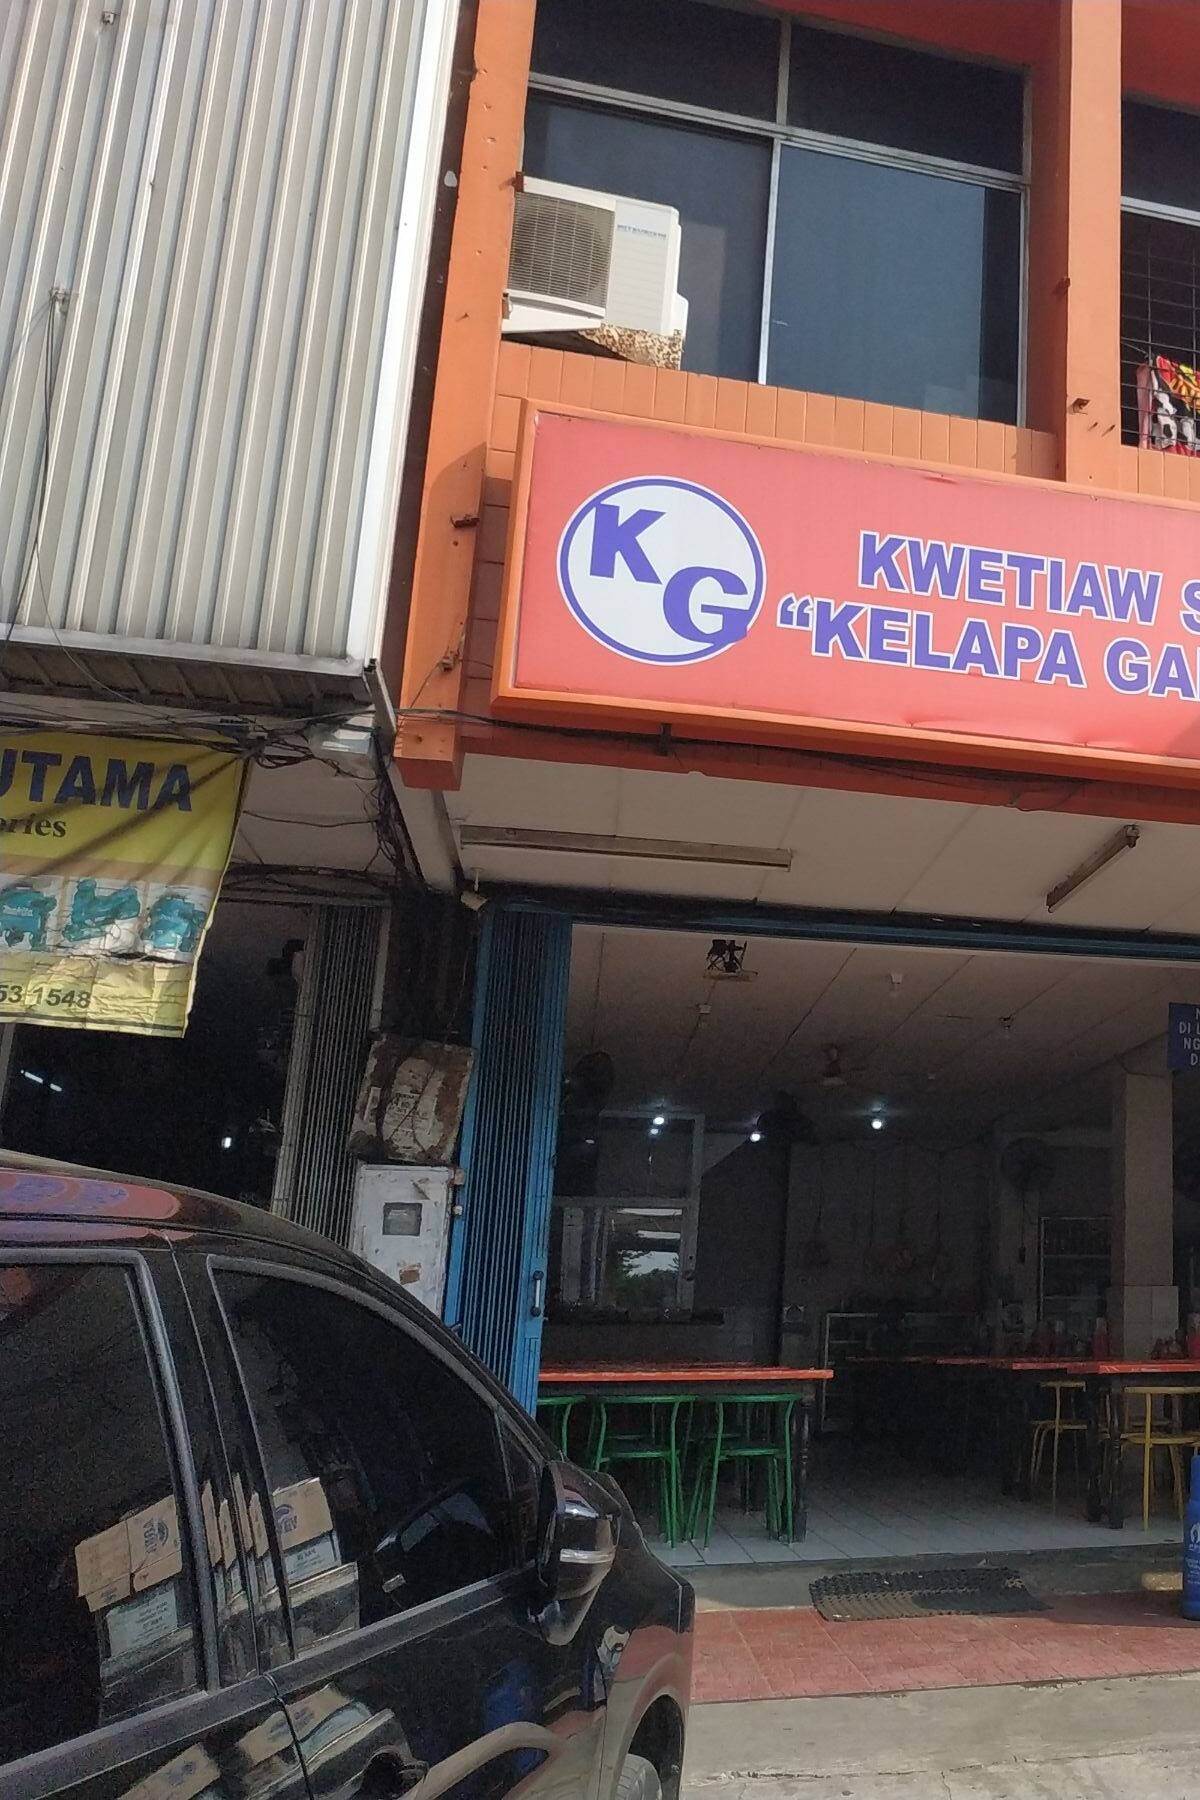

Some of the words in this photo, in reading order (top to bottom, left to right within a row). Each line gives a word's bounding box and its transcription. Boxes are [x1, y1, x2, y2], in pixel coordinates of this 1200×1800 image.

[589, 503, 749, 647] KG
[858, 529, 1163, 626] KWETIAW
[776, 592, 1087, 688] “KELAPA
